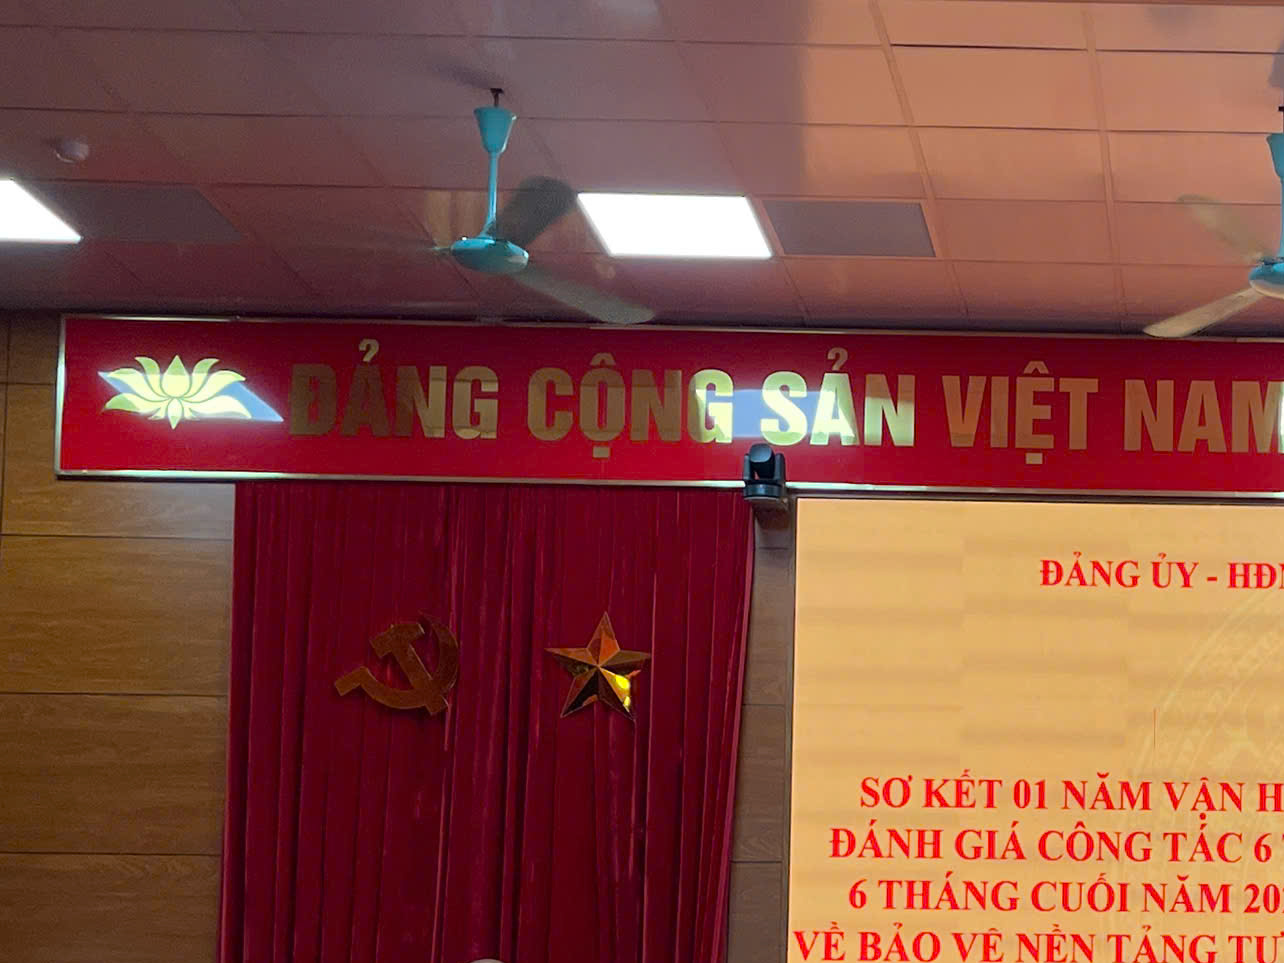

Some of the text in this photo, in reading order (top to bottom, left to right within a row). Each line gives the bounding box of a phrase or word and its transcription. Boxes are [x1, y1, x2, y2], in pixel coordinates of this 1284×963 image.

[289, 338, 499, 440] ĐẢNG
[527, 352, 735, 458] CỘNG
[759, 347, 916, 447] SẢN
[941, 360, 1098, 465] VIỆT
[1039, 551, 1141, 588] ĐẢNG
[1151, 552, 1199, 589] ỦY
[860, 774, 913, 809] SƠ
[923, 768, 1003, 809] KẾT
[1013, 778, 1047, 810] 01
[1062, 772, 1153, 811] NĂM
[1162, 776, 1245, 821] VẬN
[829, 818, 943, 859] ĐÁNH
[954, 820, 1027, 861] GIÁ
[1037, 820, 1153, 863] CÔNG
[1162, 812, 1243, 863] TÁC
[1253, 832, 1272, 863] 6
[848, 879, 867, 909] 6
[877, 870, 1020, 912] THÁNG
[1030, 872, 1129, 913] CUỐI
[1142, 874, 1232, 913] NĂM
[793, 921, 846, 961] VỀ
[858, 921, 941, 963] BẢO
[1015, 923, 1096, 963] NỀN
